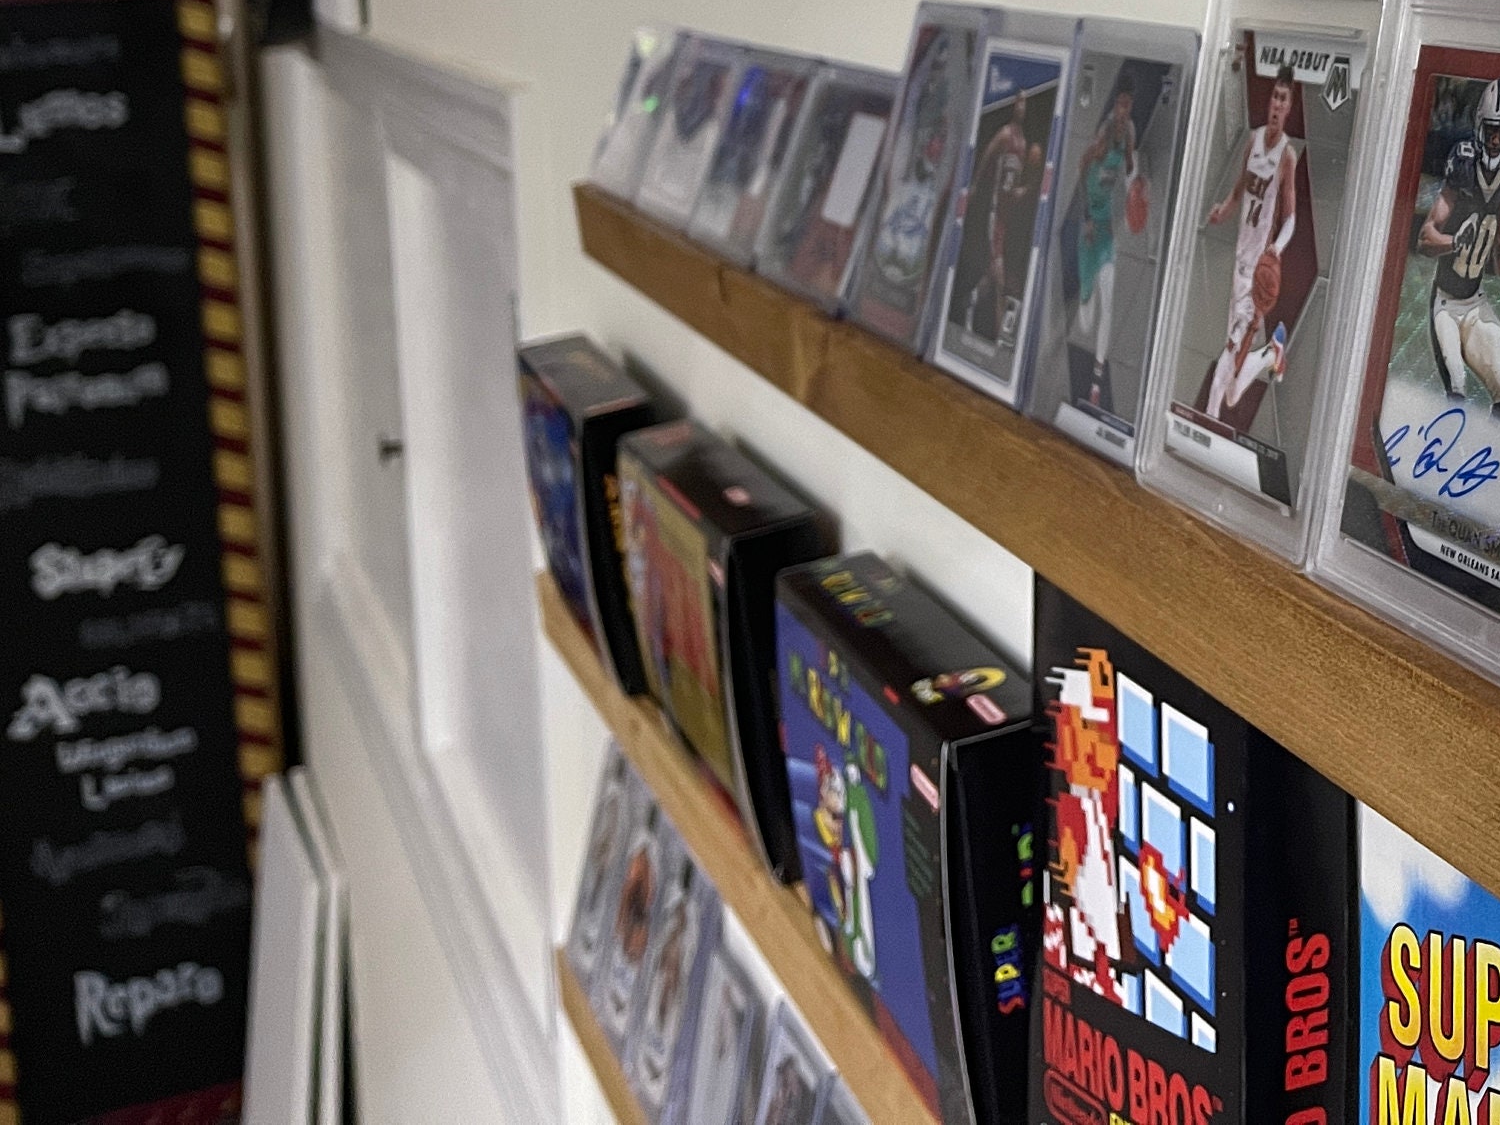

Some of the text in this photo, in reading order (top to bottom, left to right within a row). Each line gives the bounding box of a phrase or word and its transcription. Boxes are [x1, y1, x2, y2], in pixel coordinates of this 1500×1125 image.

[1260, 46, 1330, 72] NBA DEBUT
[1440, 544, 1456, 559] NEW
[1457, 552, 1490, 578] ORLEANS
[74, 961, 224, 1047] Reparo
[1043, 997, 1125, 1112] MARIO
